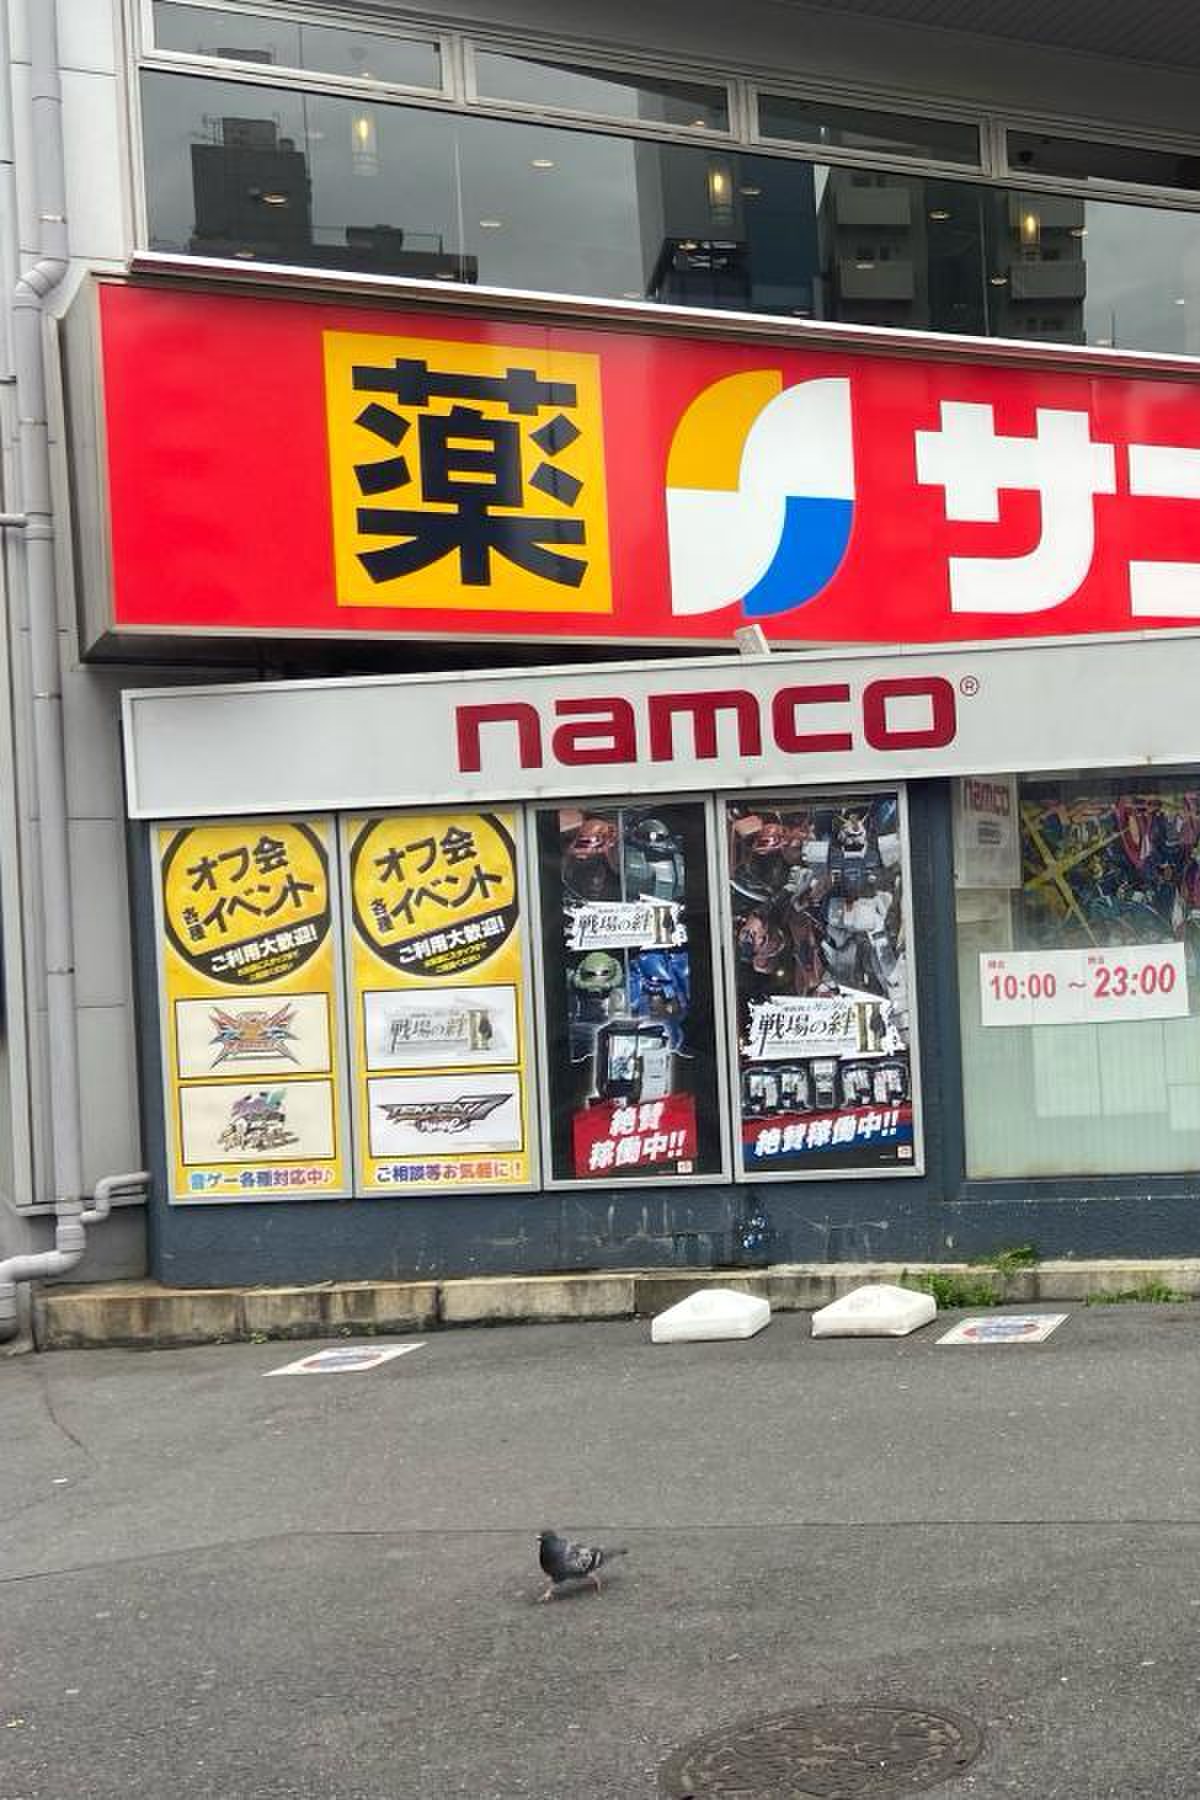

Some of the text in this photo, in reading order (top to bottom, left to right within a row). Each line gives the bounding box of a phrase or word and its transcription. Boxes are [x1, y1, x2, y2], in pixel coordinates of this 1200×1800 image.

[351, 358, 588, 588] 薬
[455, 675, 958, 773] namco
[187, 835, 289, 892] オフ会
[373, 826, 478, 883] オフ会
[203, 872, 315, 933] イベント
[390, 863, 503, 925] イベント
[990, 973, 1057, 1000] 10:00
[1094, 963, 1177, 998] 23:00
